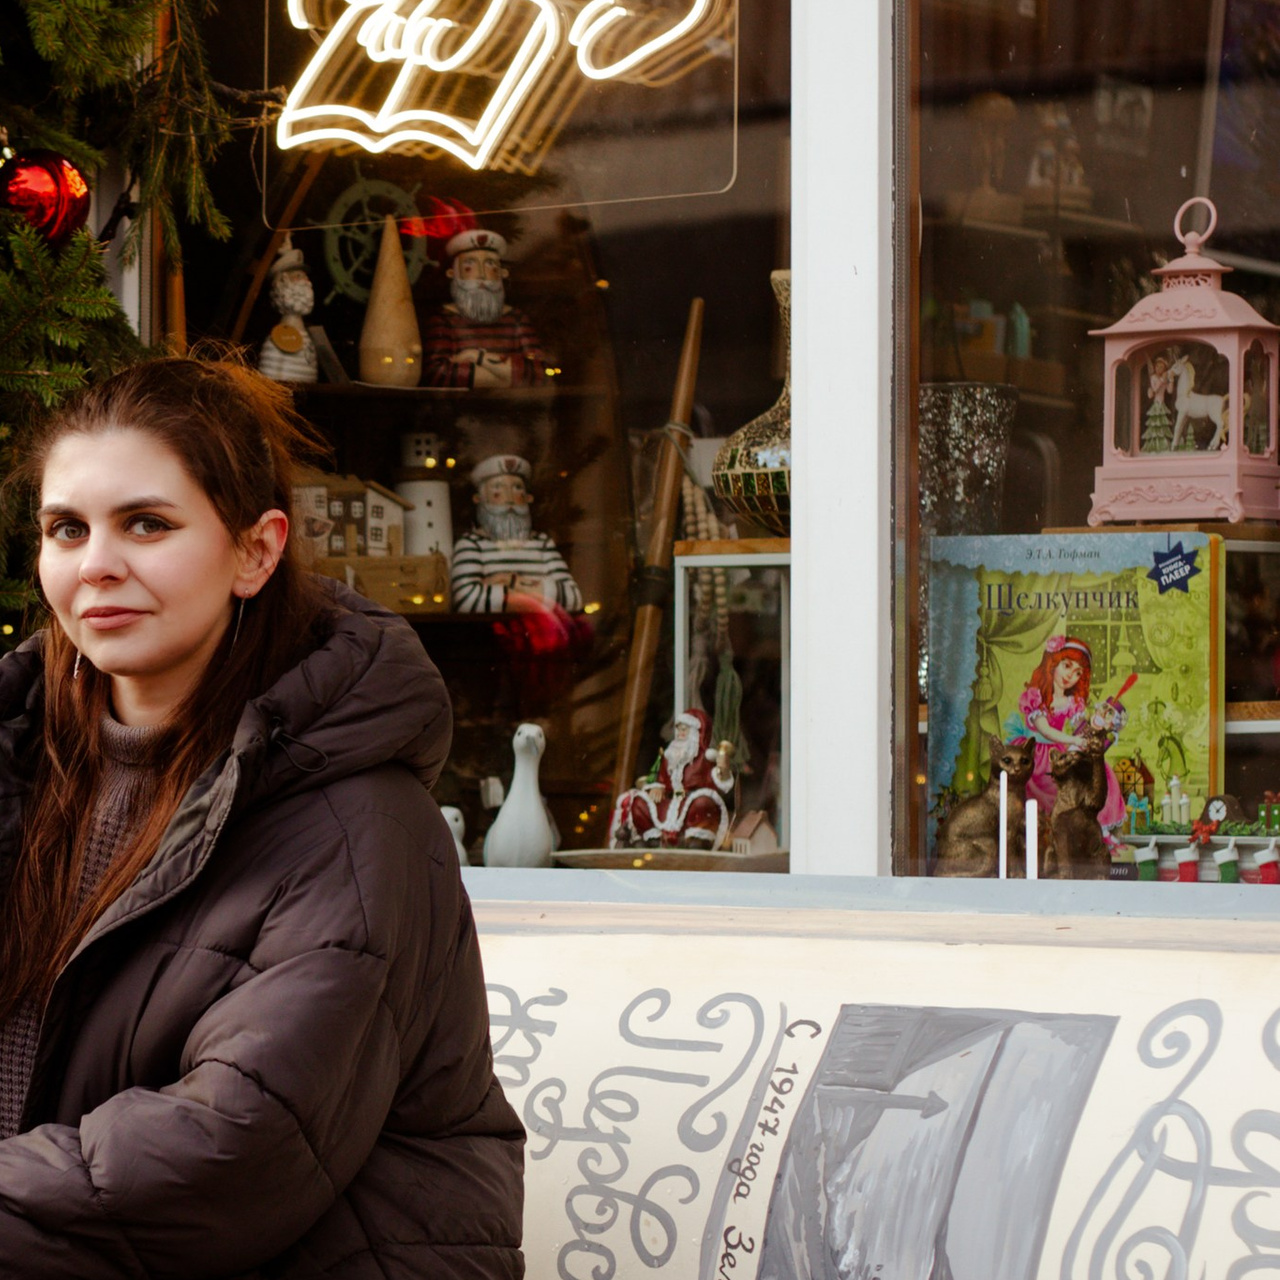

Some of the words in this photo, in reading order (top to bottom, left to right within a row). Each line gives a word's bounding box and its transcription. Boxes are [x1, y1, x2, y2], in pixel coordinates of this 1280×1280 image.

[1058, 547, 1101, 562] Гофман
[1160, 564, 1191, 586] ПЛЕЕР
[986, 582, 1140, 618] Щелкунчик
[757, 1062, 800, 1136] 1947
[727, 1142, 766, 1204] года
